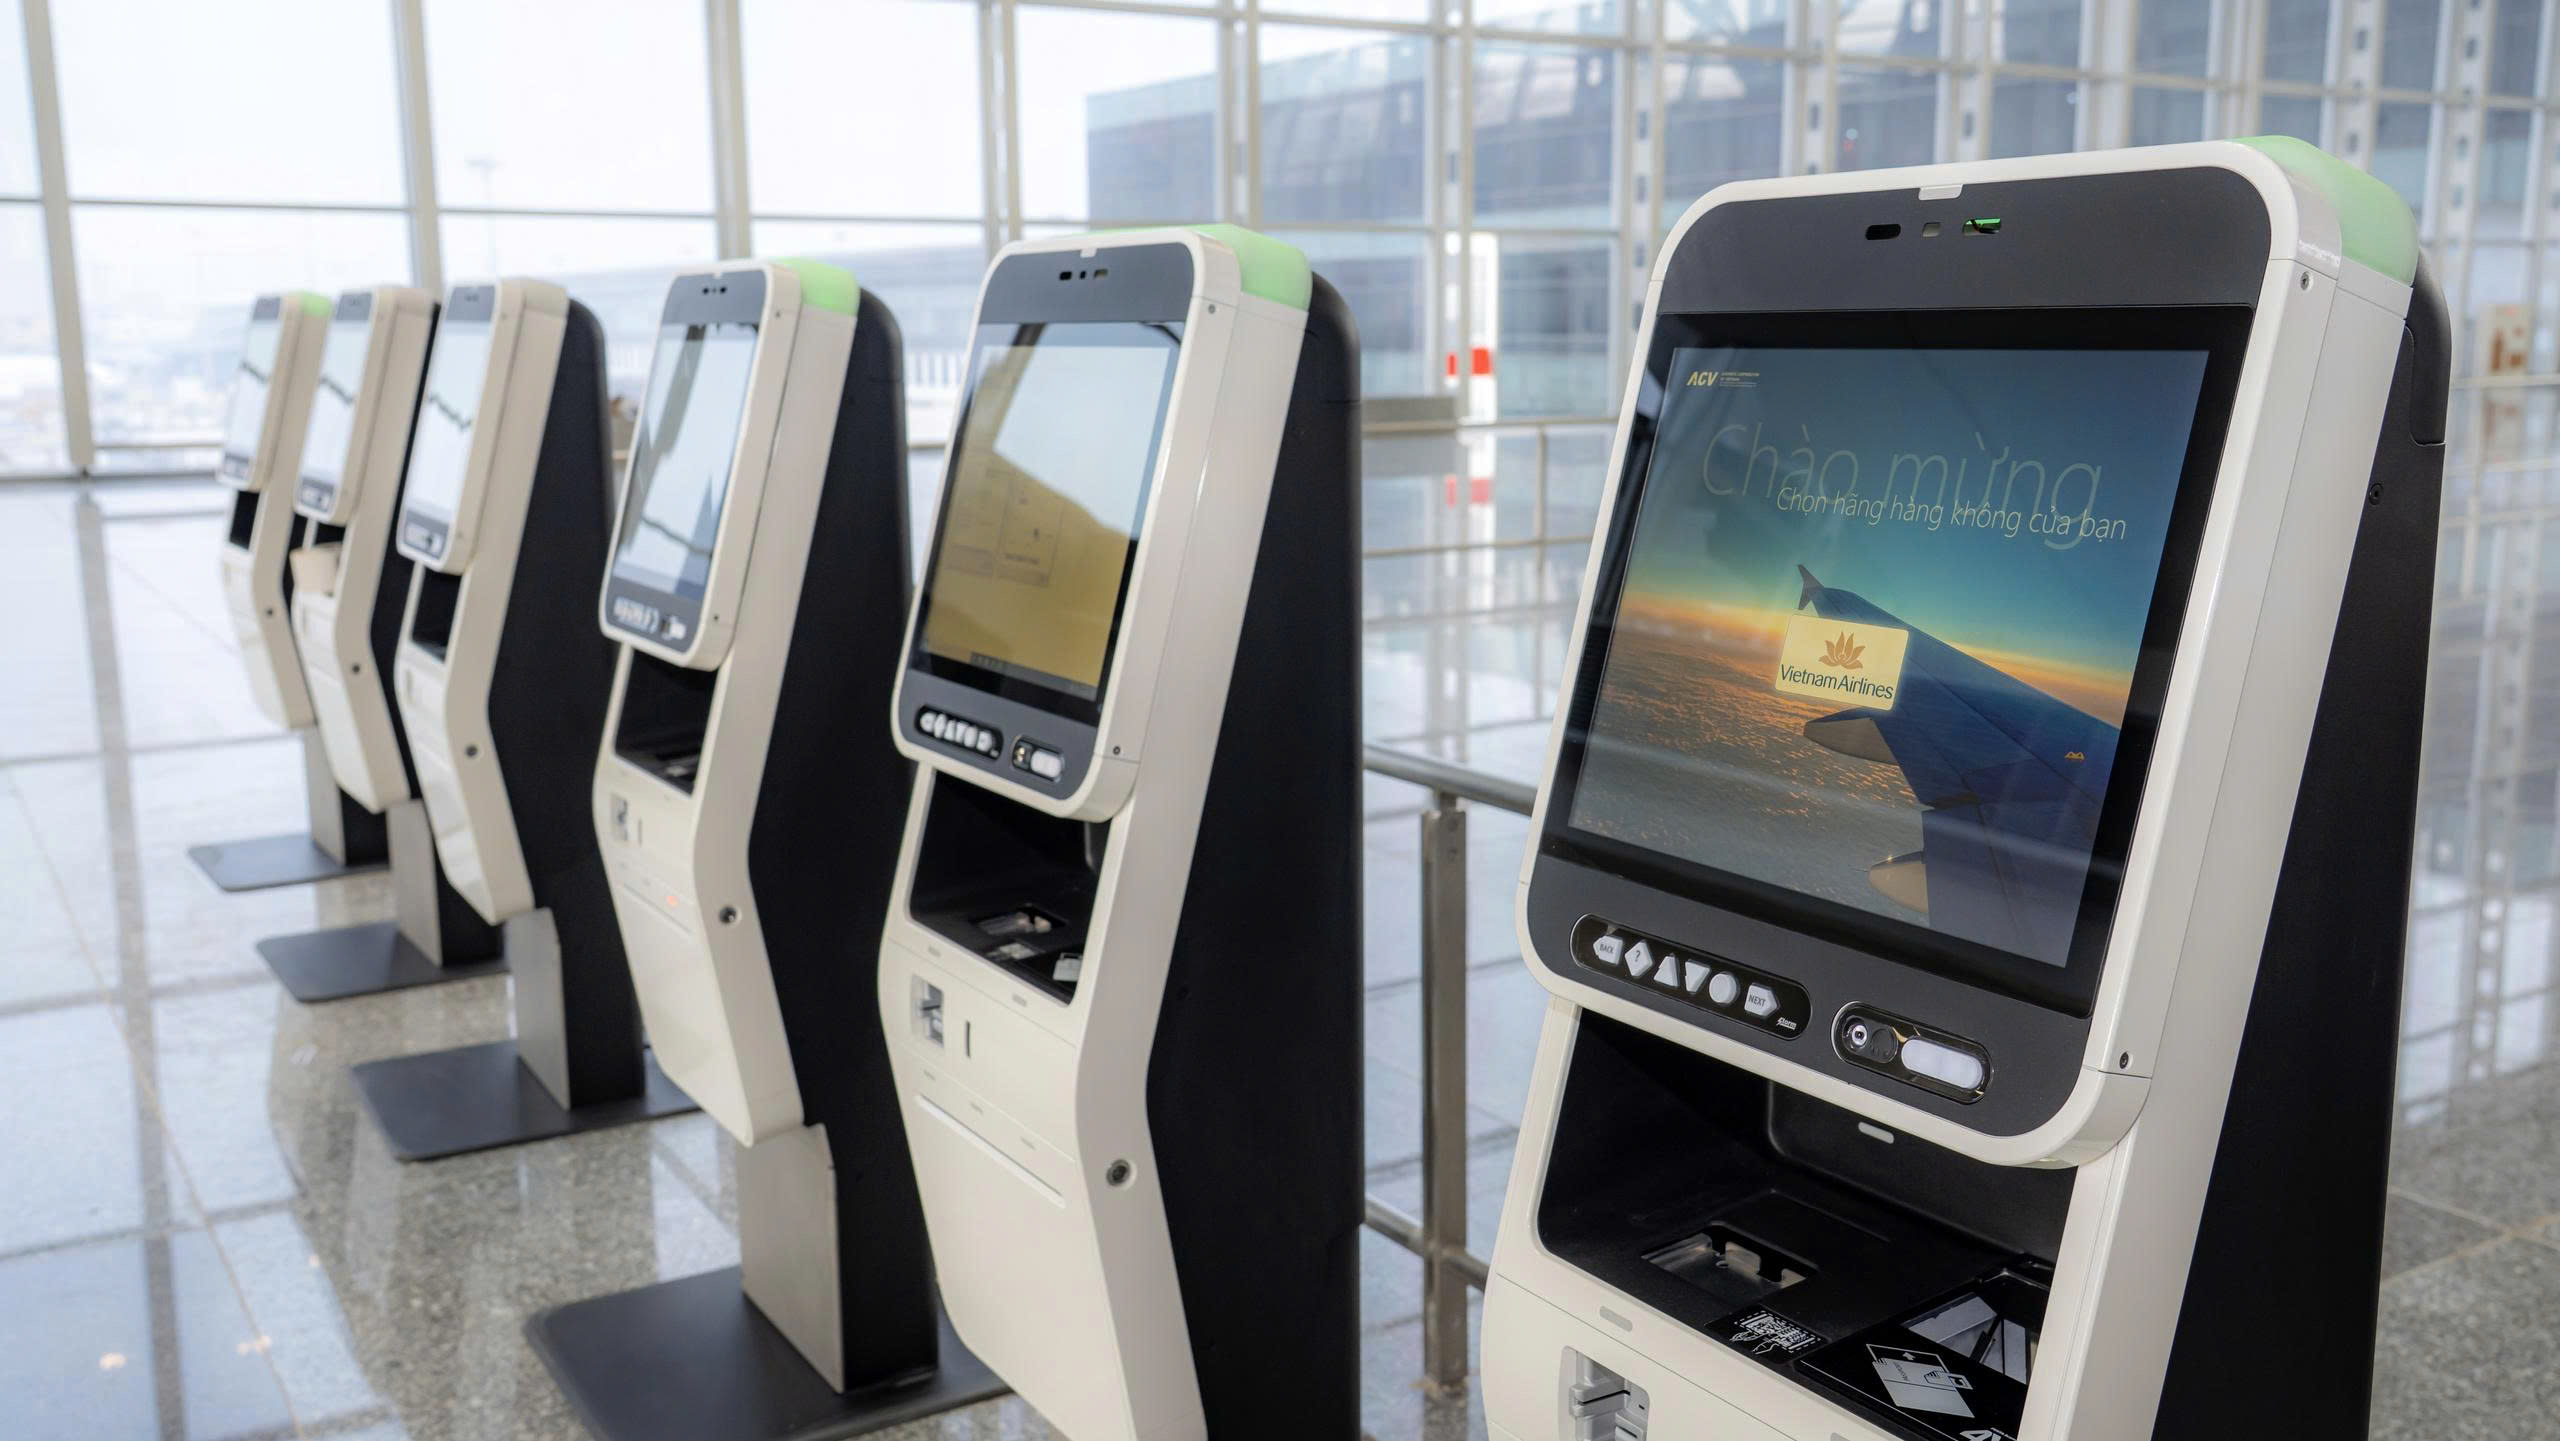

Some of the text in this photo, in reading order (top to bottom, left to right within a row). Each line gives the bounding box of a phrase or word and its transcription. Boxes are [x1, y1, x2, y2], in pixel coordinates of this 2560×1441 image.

[1686, 371, 1719, 386] ACV
[1703, 422, 2102, 550] Chào mừng
[1776, 486, 2127, 542] Chọn hãng hàng không của bạn
[1781, 664, 1894, 700] Vietnam Airlines
[1599, 943, 1614, 954] BACK
[1748, 994, 1766, 1007] NEXT
